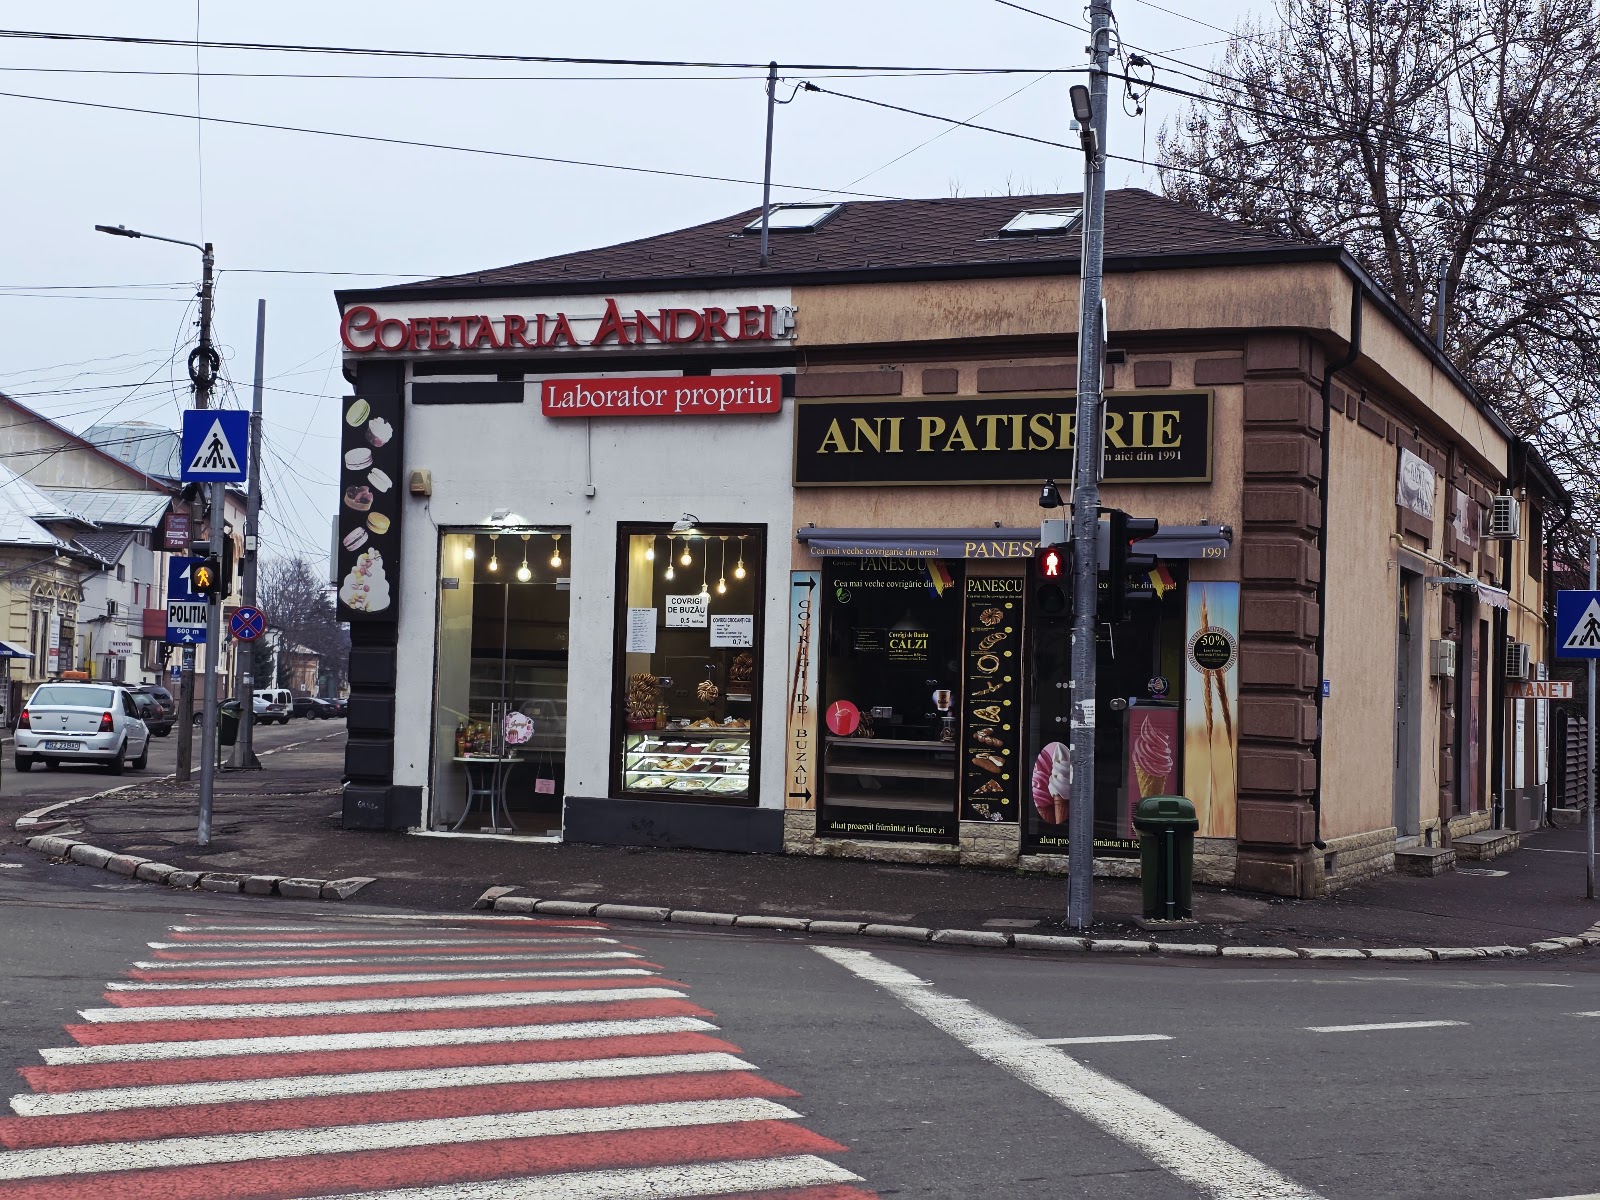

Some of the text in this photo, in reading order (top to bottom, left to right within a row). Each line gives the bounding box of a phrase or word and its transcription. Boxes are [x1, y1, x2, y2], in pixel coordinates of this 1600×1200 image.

[340, 298, 775, 353] COFETARIA ANDREI
[547, 381, 773, 412] Laborator propriu
[816, 409, 1183, 454] ANI PATISERIE
[1114, 451, 1134, 461] aici
[1136, 451, 1154, 461] din
[1157, 450, 1182, 461] 1991
[810, 546, 825, 555] Cea
[826, 546, 840, 555] mai
[842, 547, 864, 556] veche
[905, 548, 918, 556] din
[919, 548, 939, 557] oras!
[1200, 547, 1226, 558] 1991
[833, 579, 848, 588] Cea
[849, 580, 863, 588] mai
[864, 579, 885, 588] veche
[967, 580, 1023, 592] PANESCU
[671, 597, 703, 605] COVRIGI
[667, 606, 678, 614] DE
[889, 639, 928, 649] CALZI
[1200, 635, 1225, 646] -50%
[797, 693, 809, 715] DE
[794, 728, 808, 785] BUZAU
[830, 821, 846, 830] aluat
[938, 826, 945, 835] zi
[1039, 836, 1056, 844] aluat
[1122, 839, 1129, 848] in
